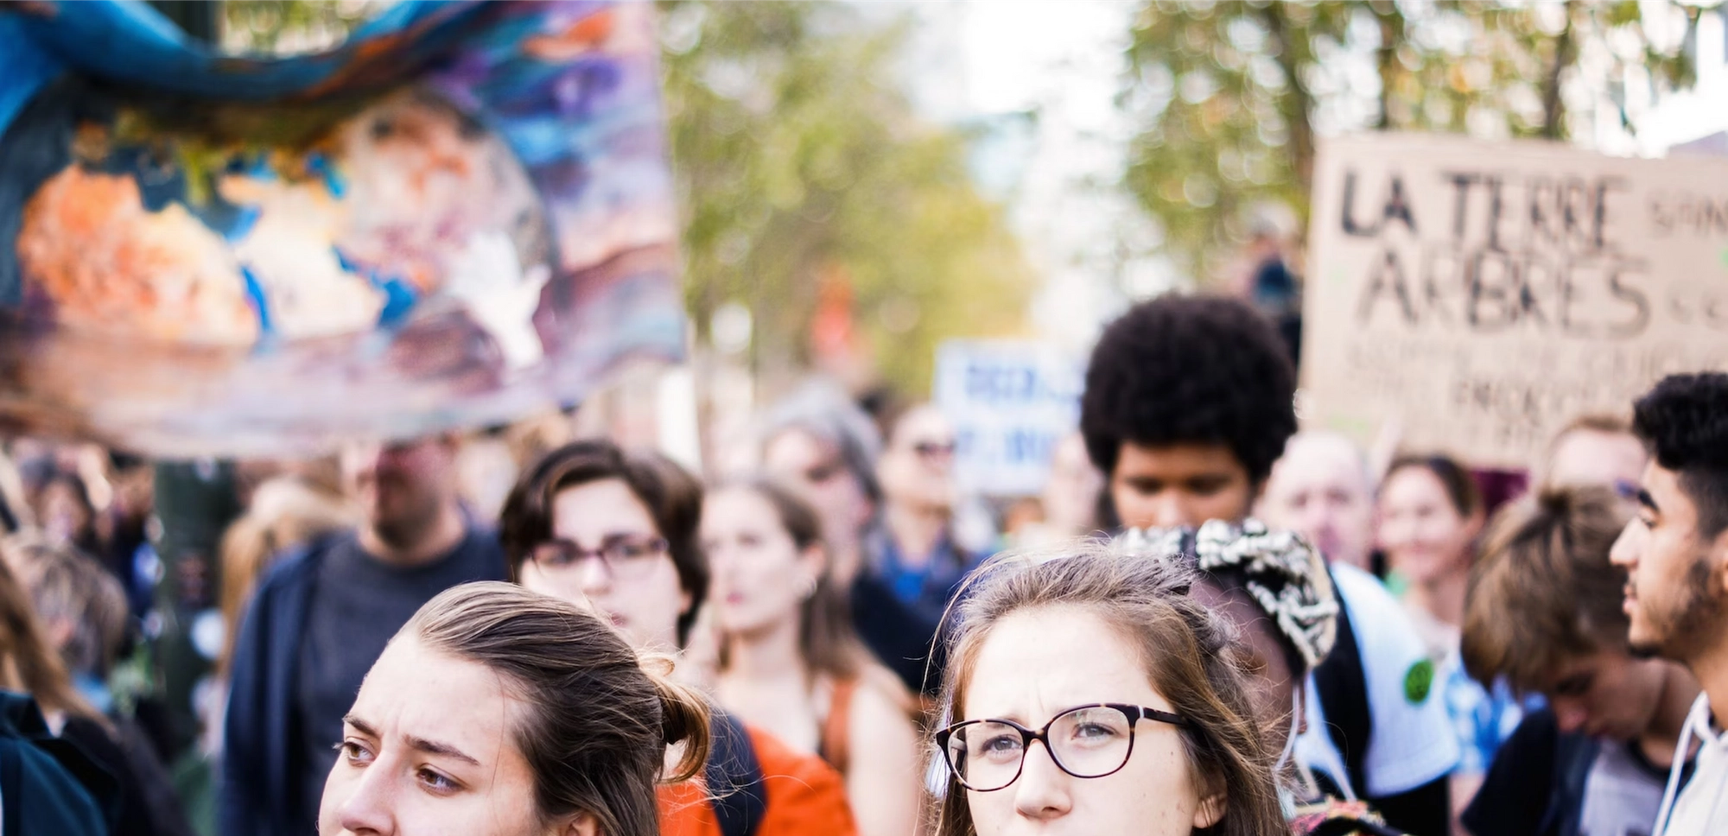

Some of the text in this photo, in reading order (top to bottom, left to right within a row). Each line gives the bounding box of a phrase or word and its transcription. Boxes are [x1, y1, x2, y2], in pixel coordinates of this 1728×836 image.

[1338, 169, 1419, 240] LA
[1438, 171, 1631, 252] TERRE
[1355, 243, 1652, 340] ARBRES
